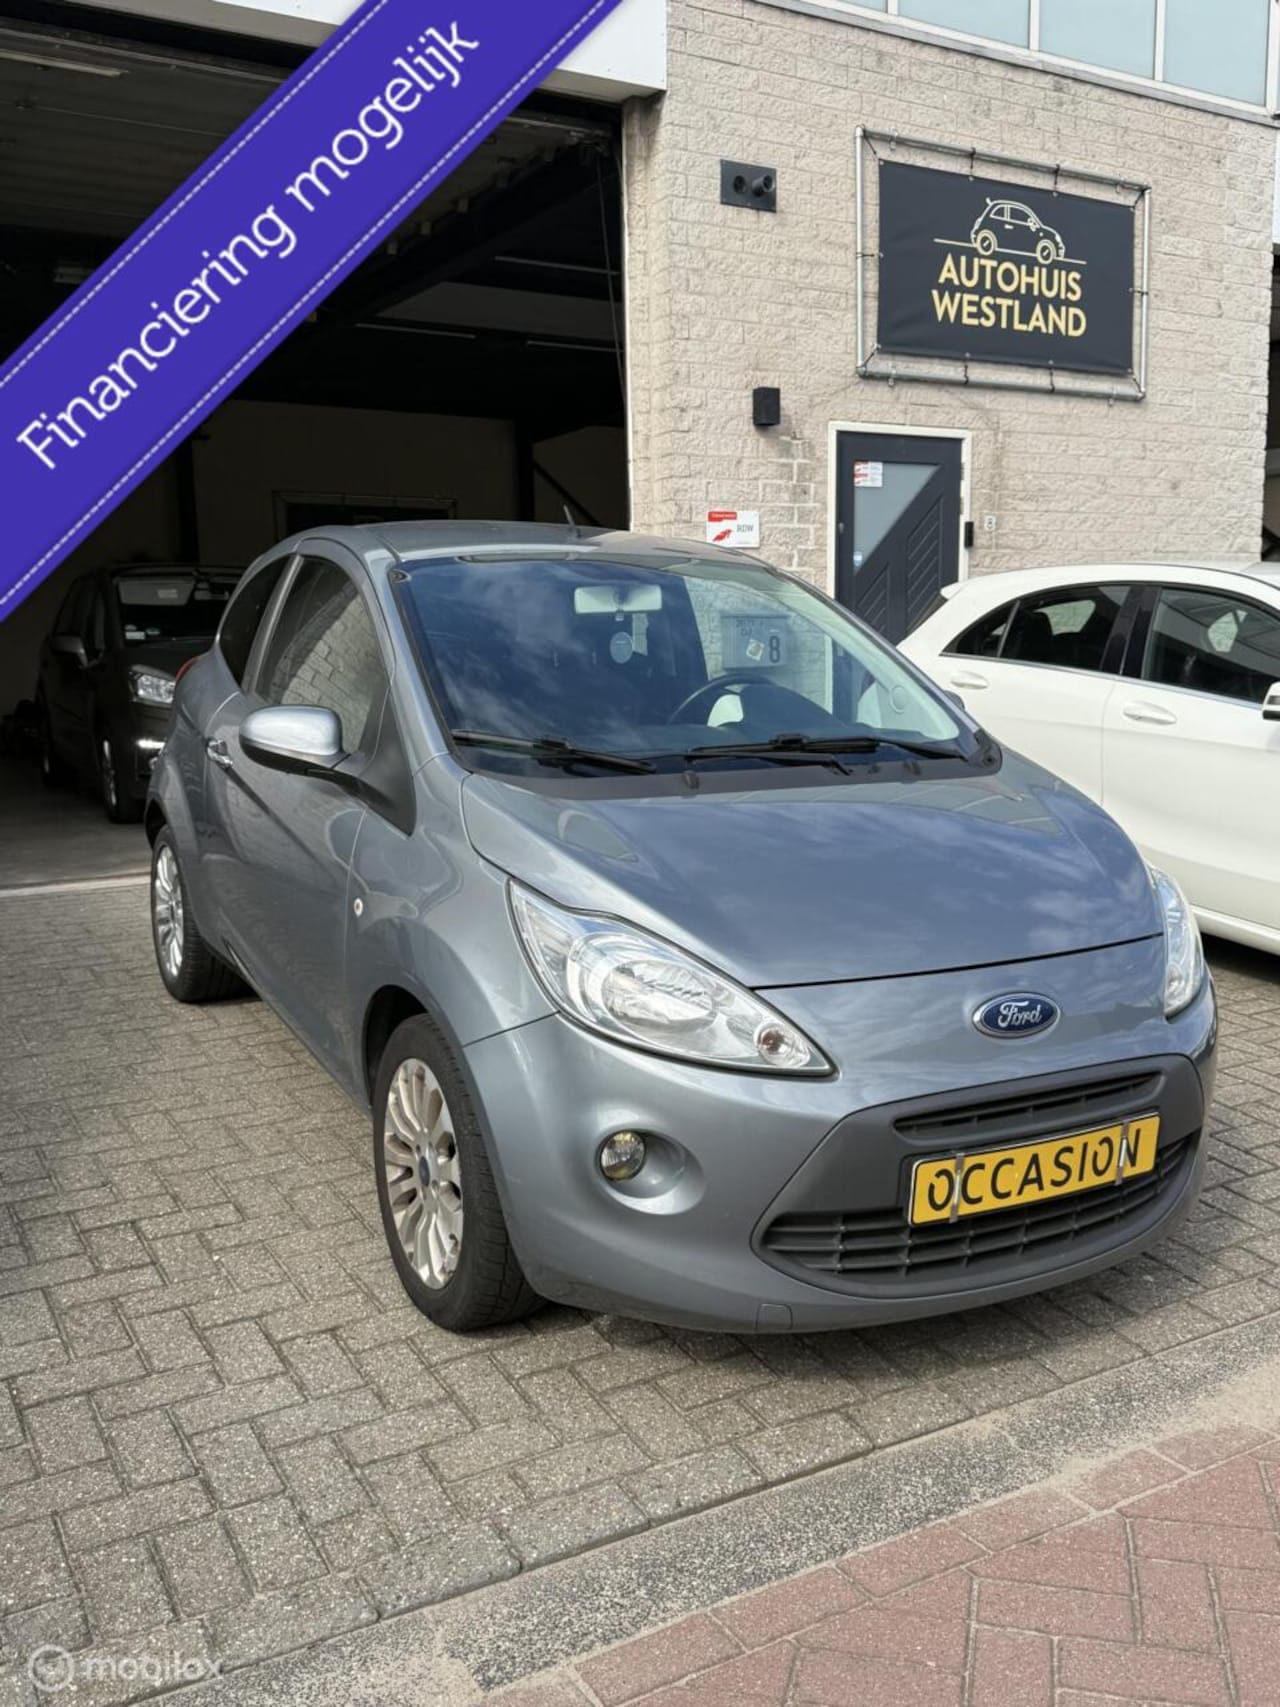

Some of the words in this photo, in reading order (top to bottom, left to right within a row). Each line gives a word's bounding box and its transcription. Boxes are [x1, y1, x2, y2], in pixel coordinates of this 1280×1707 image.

[938, 253, 1082, 301] AUTOHUIS
[931, 289, 1087, 337] WESTLAND
[769, 635, 780, 663] 8
[998, 1001, 1042, 1028] Ford
[928, 1128, 1141, 1211] OCCASION
